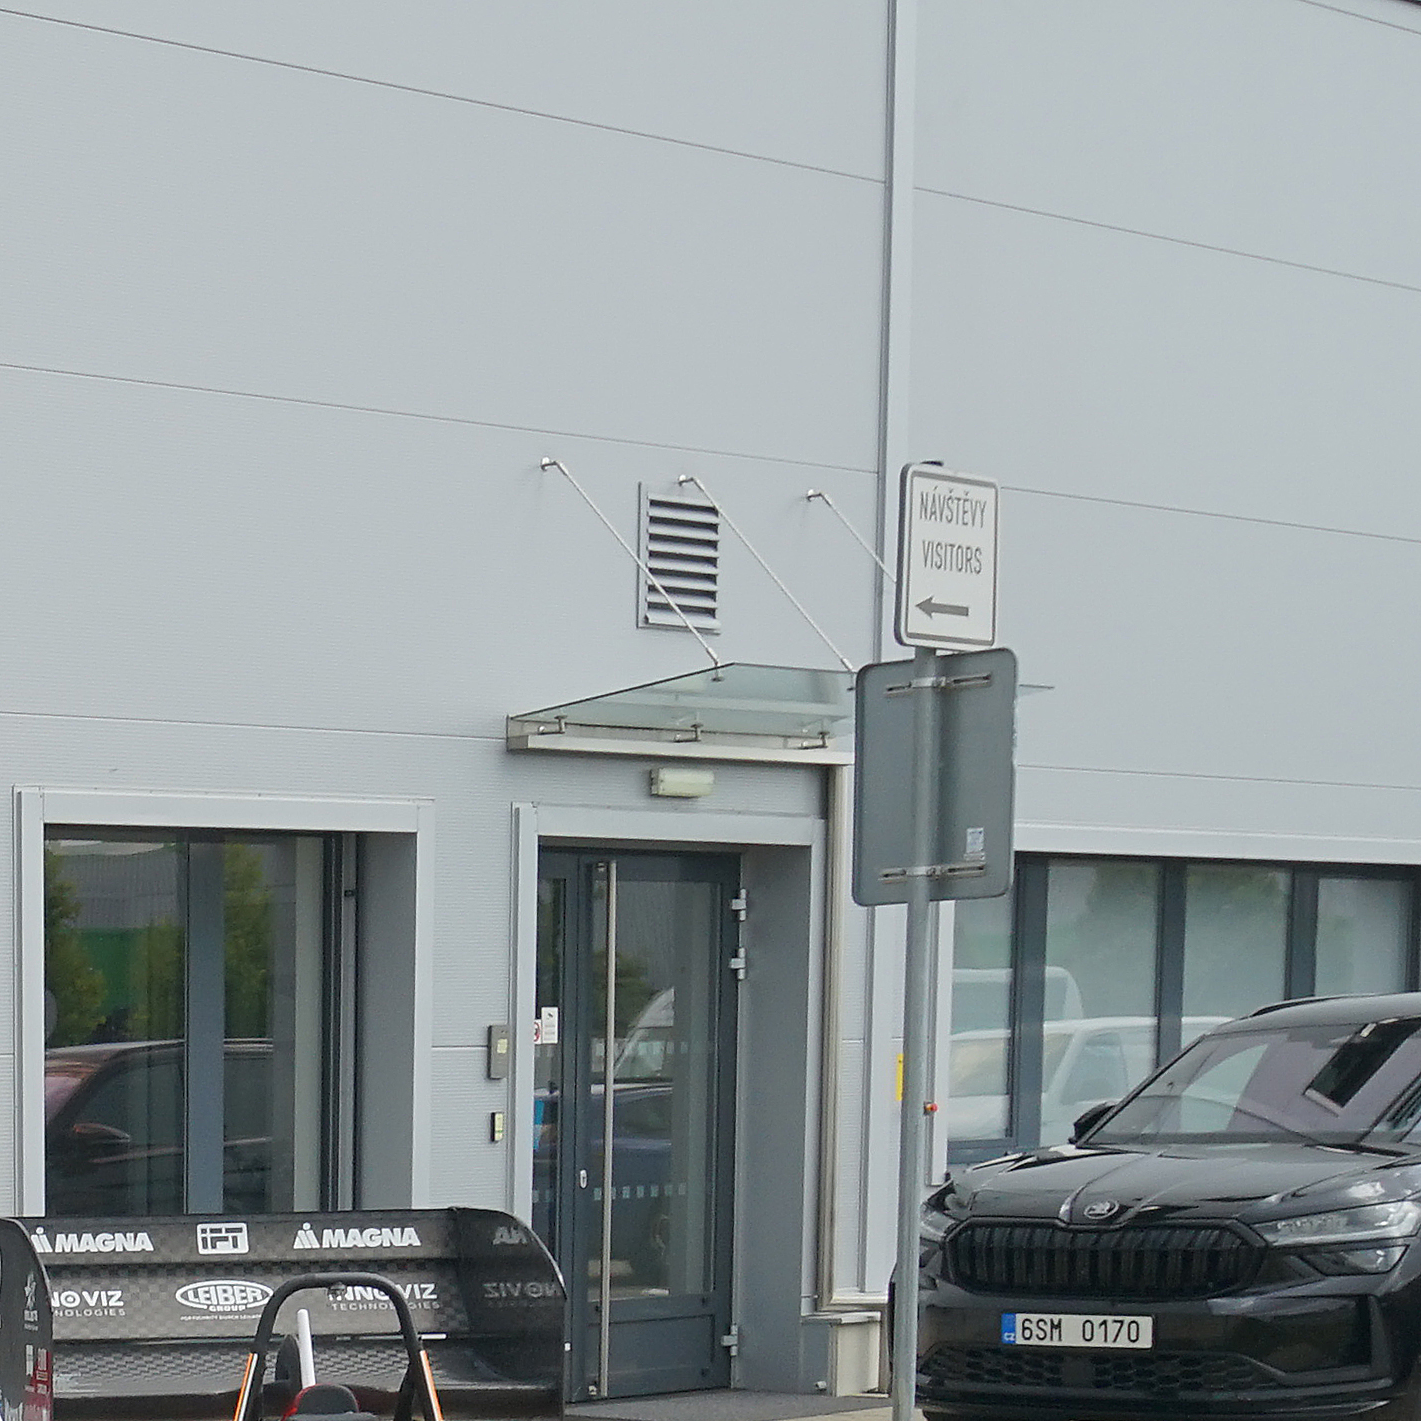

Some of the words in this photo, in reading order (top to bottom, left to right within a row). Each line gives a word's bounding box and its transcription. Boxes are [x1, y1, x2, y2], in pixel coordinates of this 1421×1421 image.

[919, 485, 987, 528] NÁVŠTĚVY
[922, 539, 983, 575] VISITORS
[55, 1233, 154, 1252] MAGNA
[322, 1227, 422, 1248] MAGNA
[187, 1285, 263, 1305] LEIBER
[209, 1304, 247, 1312] GROUP
[332, 1301, 441, 1312] TECHNOLGIES
[1021, 1317, 1063, 1342] 6SM
[1081, 1319, 1141, 1343] 0170
